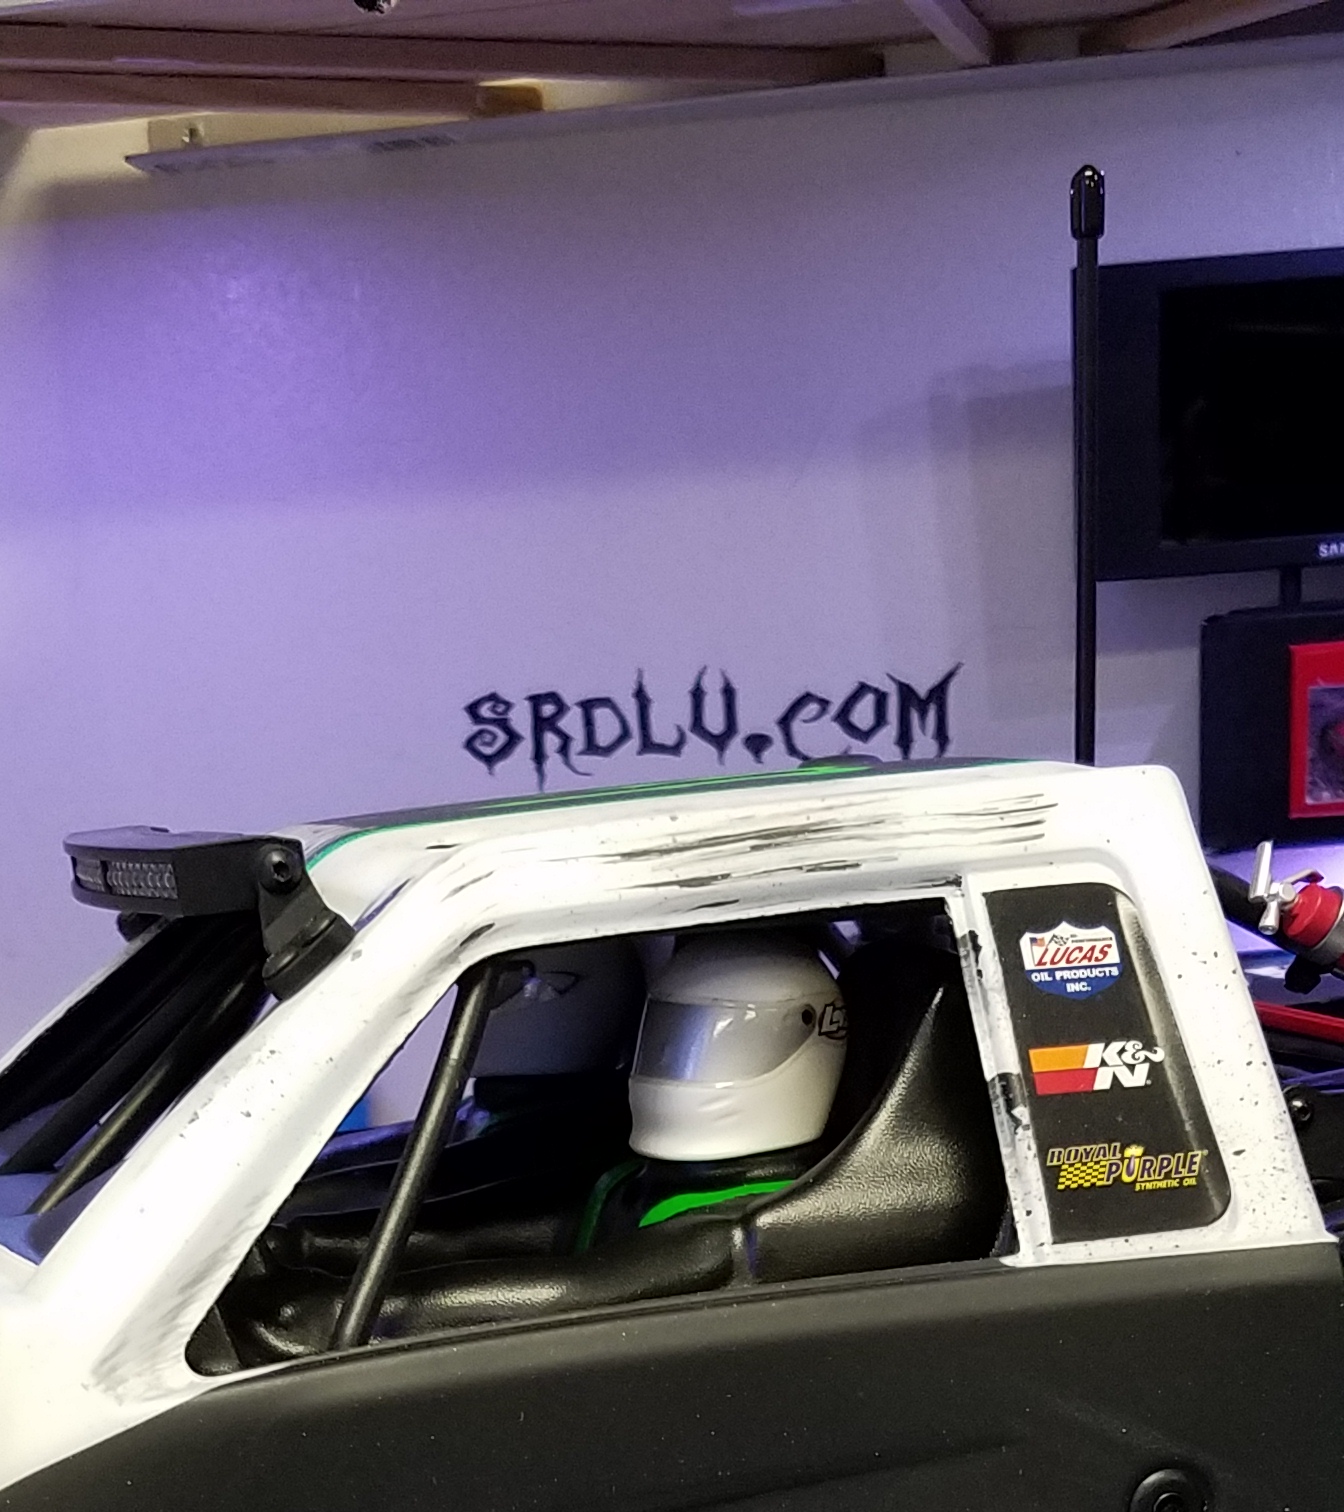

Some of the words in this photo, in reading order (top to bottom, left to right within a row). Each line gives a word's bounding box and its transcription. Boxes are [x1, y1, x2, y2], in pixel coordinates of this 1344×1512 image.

[1035, 943, 1112, 967] LUCAS
[1031, 969, 1053, 983] OIL
[1054, 966, 1120, 981] PRODUCTS
[1065, 981, 1092, 993] INC.
[1046, 1142, 1122, 1166] ROYAL
[1104, 1150, 1202, 1185] PURPLE
[1135, 1179, 1180, 1191] SYNTHETIC
[1182, 1177, 1197, 1187] OIL
